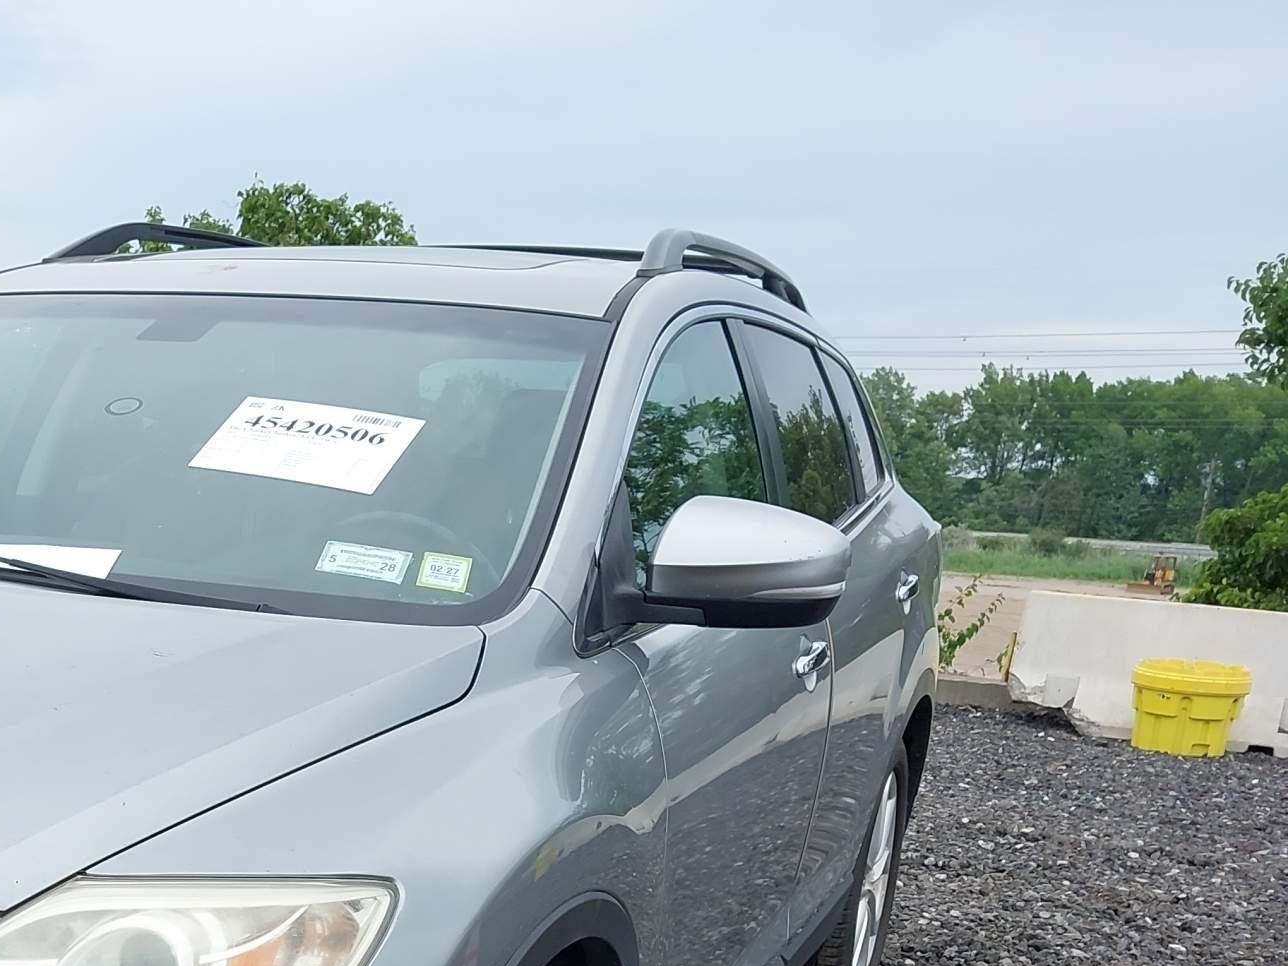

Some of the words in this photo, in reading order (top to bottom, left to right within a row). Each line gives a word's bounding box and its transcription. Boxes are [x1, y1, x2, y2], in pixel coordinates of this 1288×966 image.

[244, 414, 388, 446] 45420506
[327, 554, 337, 563] 5
[379, 562, 397, 573] 28
